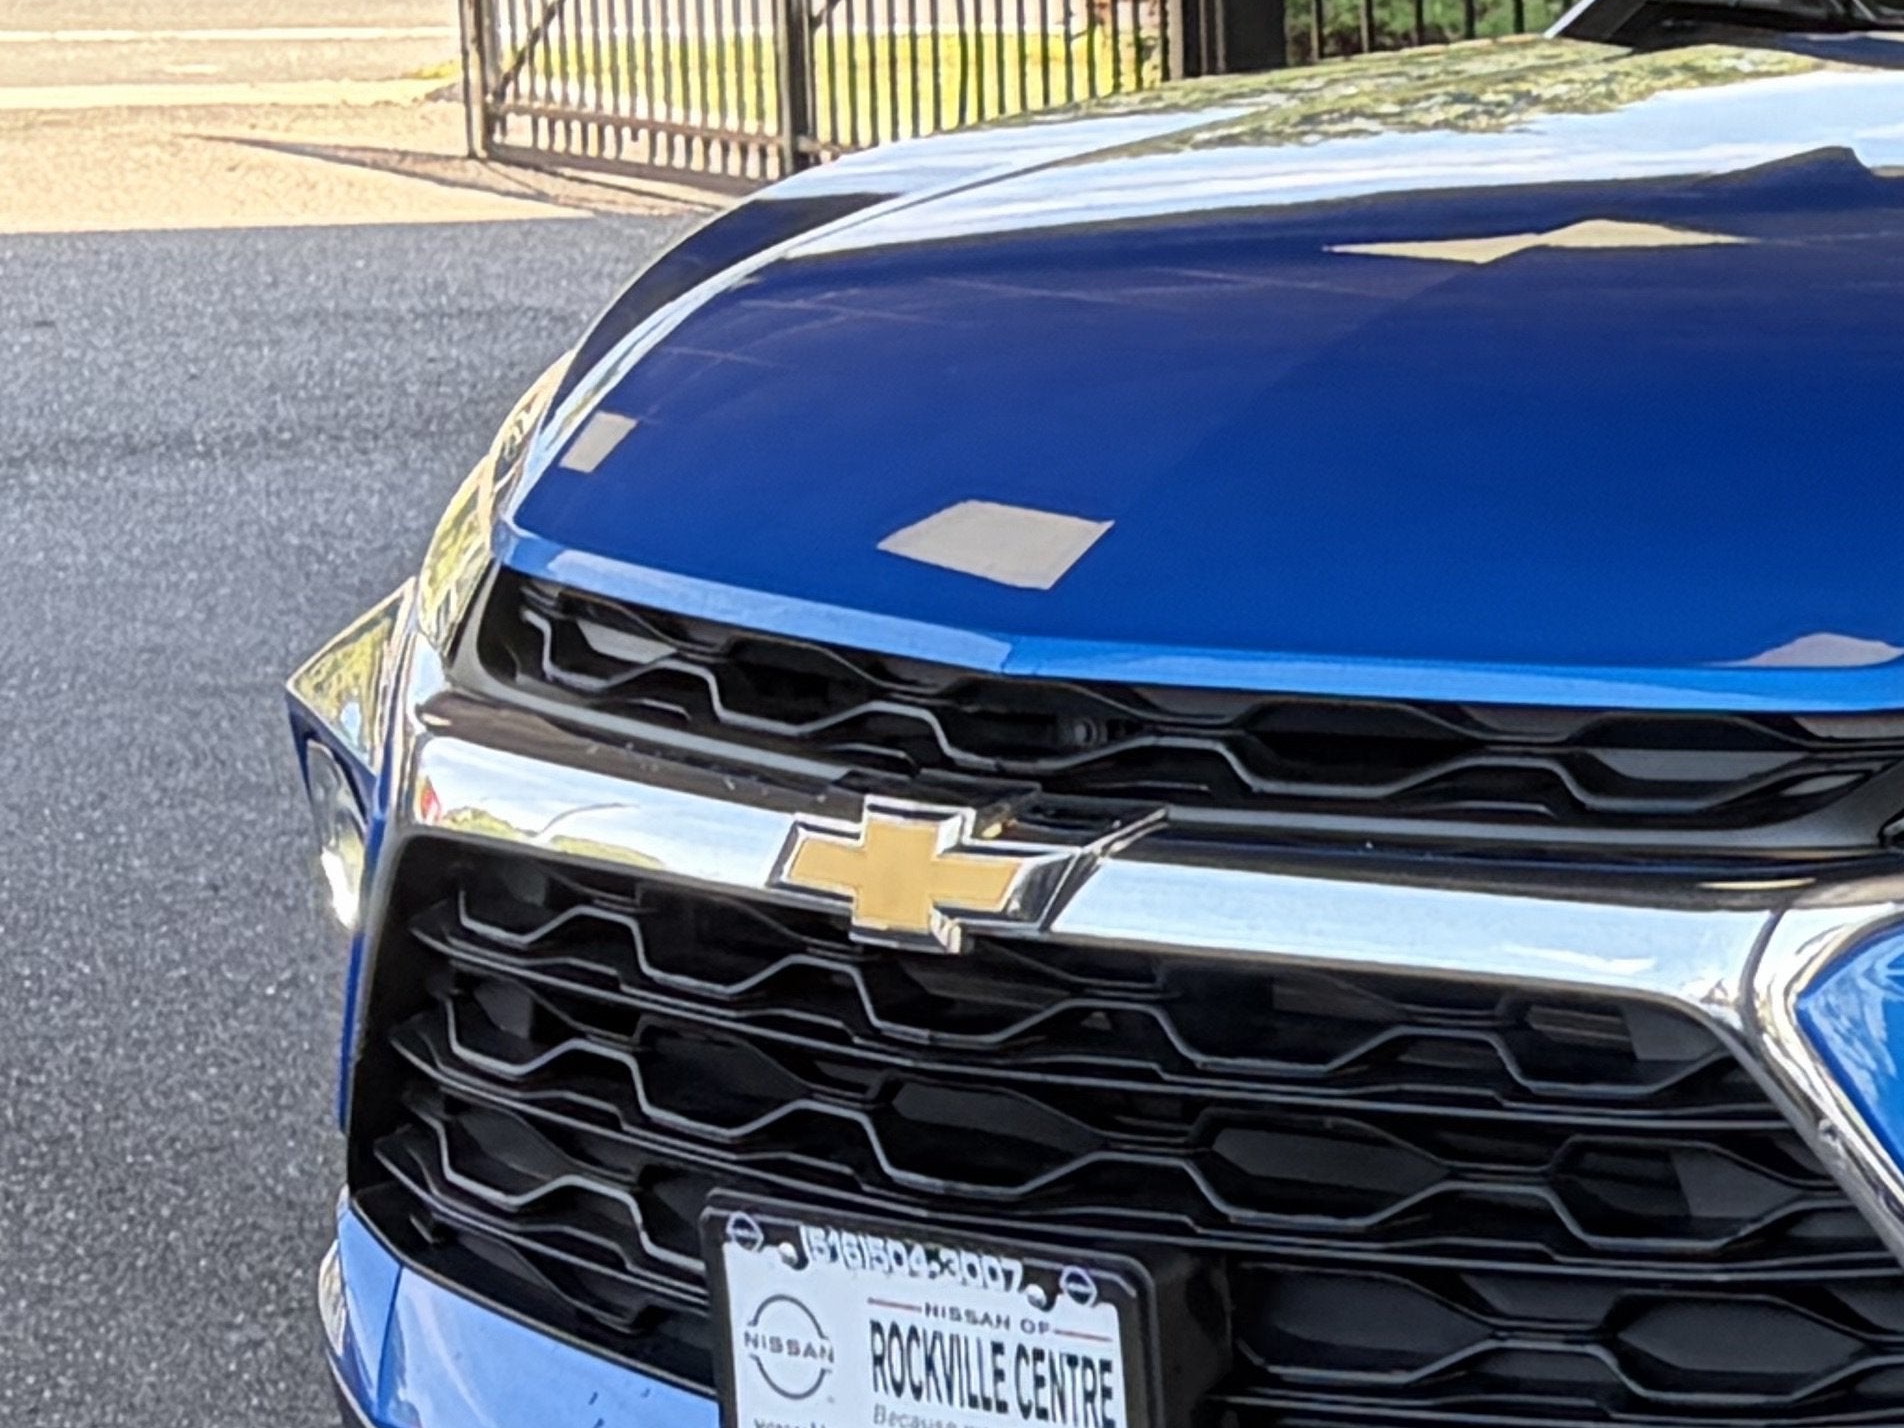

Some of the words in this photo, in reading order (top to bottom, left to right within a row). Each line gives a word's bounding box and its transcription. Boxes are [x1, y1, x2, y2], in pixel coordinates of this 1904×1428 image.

[925, 1303, 1010, 1331] NISSAN
[1020, 1312, 1050, 1334] OF
[744, 1330, 835, 1363] NISSAN
[870, 1320, 1009, 1414] ROCKVILLE
